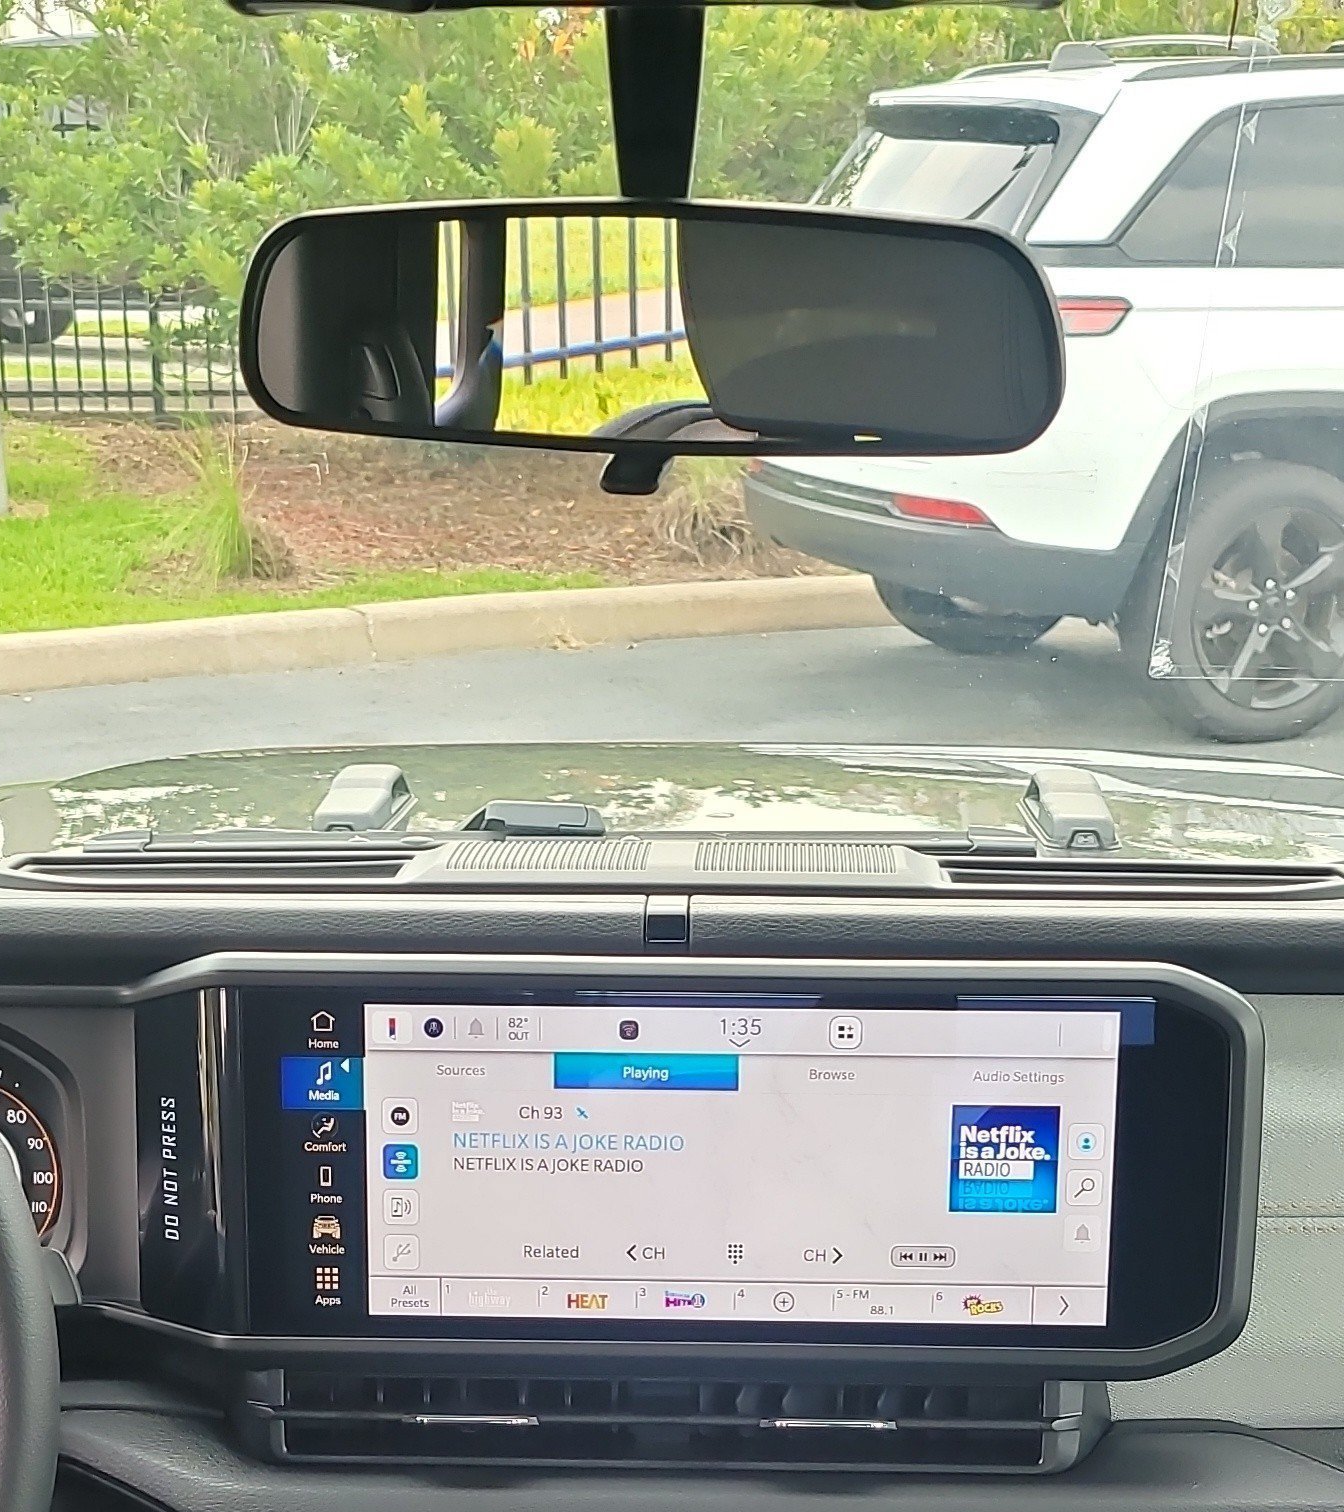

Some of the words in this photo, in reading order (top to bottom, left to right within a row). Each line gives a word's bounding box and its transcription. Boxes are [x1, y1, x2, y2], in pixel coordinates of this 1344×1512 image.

[720, 1018, 762, 1036] 1:35
[508, 1032, 530, 1041] OUT
[308, 1038, 339, 1049] Home
[436, 1065, 486, 1076] Sources
[622, 1065, 669, 1082] Playing
[809, 1068, 855, 1081] Browse
[973, 1071, 1010, 1084] Audio
[1013, 1071, 1065, 1086] Settings
[308, 1090, 340, 1101] Media
[6, 1110, 27, 1124] 80
[519, 1106, 540, 1119] Ch
[543, 1107, 563, 1119] 93
[161, 1097, 177, 1160] PRESS
[960, 1125, 1035, 1143] Netflix
[27, 1138, 43, 1150] 90
[304, 1141, 346, 1152] Comfort
[453, 1132, 529, 1149] NETFLIX
[534, 1133, 550, 1149] IS
[555, 1133, 568, 1150] A
[572, 1134, 620, 1153] JOKE
[623, 1135, 684, 1151] RADIO
[959, 1142, 979, 1159] is
[981, 1146, 994, 1159] a
[453, 1157, 518, 1170] NETFLIX
[521, 1158, 534, 1171] IS
[537, 1158, 548, 1171] A
[550, 1158, 589, 1174] JOKE
[594, 1159, 644, 1173] RADIO
[963, 1162, 1011, 1177] RADIO
[33, 1172, 54, 1184] 100
[163, 1167, 179, 1206] NOT
[310, 1193, 343, 1203] Phone
[31, 1201, 47, 1213] 110
[164, 1214, 180, 1240] DO
[309, 1244, 345, 1255] Vehicle
[523, 1245, 579, 1259] Related
[642, 1247, 665, 1260] CH
[803, 1250, 827, 1262] CH
[402, 1284, 417, 1295] All
[445, 1284, 451, 1294] 1
[541, 1286, 549, 1296] 2
[639, 1287, 647, 1297] 3
[737, 1289, 745, 1298] 4
[837, 1289, 844, 1299] 5
[853, 1290, 869, 1299] FM
[315, 1295, 341, 1306] Apps
[567, 1293, 609, 1309] HEAT
[935, 1291, 943, 1301] 6
[391, 1298, 430, 1309] Presets
[870, 1305, 894, 1315] 88.1
